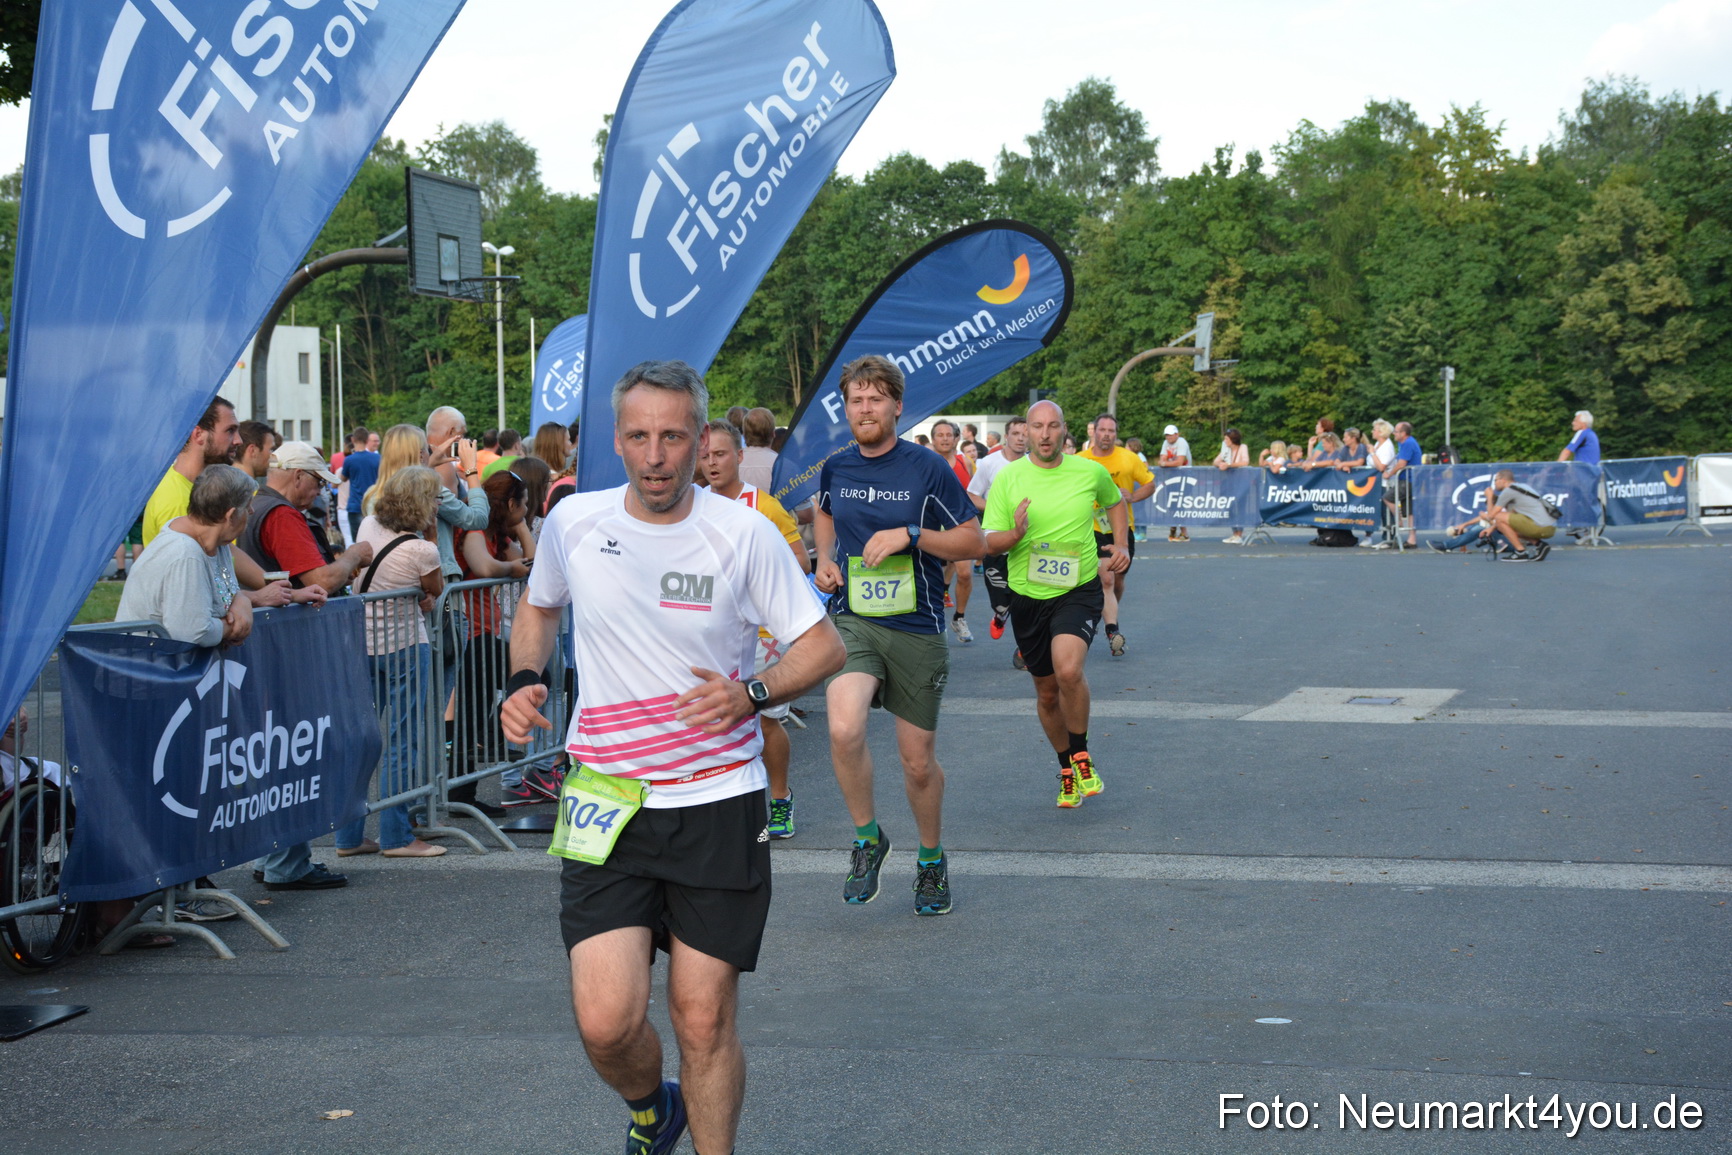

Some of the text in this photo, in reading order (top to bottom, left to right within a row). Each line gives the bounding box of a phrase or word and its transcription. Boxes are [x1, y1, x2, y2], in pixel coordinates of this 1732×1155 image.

[158, 0, 323, 170] Fis
[667, 20, 830, 275] Fischer
[719, 70, 850, 271] AUTOMOBILE
[935, 298, 1056, 375] Druck und Medien
[840, 487, 910, 501] EURO POLES
[1267, 485, 1348, 503] Frischmann
[1606, 479, 1667, 498] Frischmann
[1167, 492, 1235, 509] Fischer
[1334, 504, 1348, 513] und
[1173, 510, 1230, 519] AUTOMOBILE
[600, 547, 621, 556] erima
[1037, 558, 1070, 576] 236
[861, 580, 900, 600] 367
[200, 710, 331, 795] Fischer
[705, 767, 727, 777] balance
[209, 775, 321, 832] AUTOMOBILE
